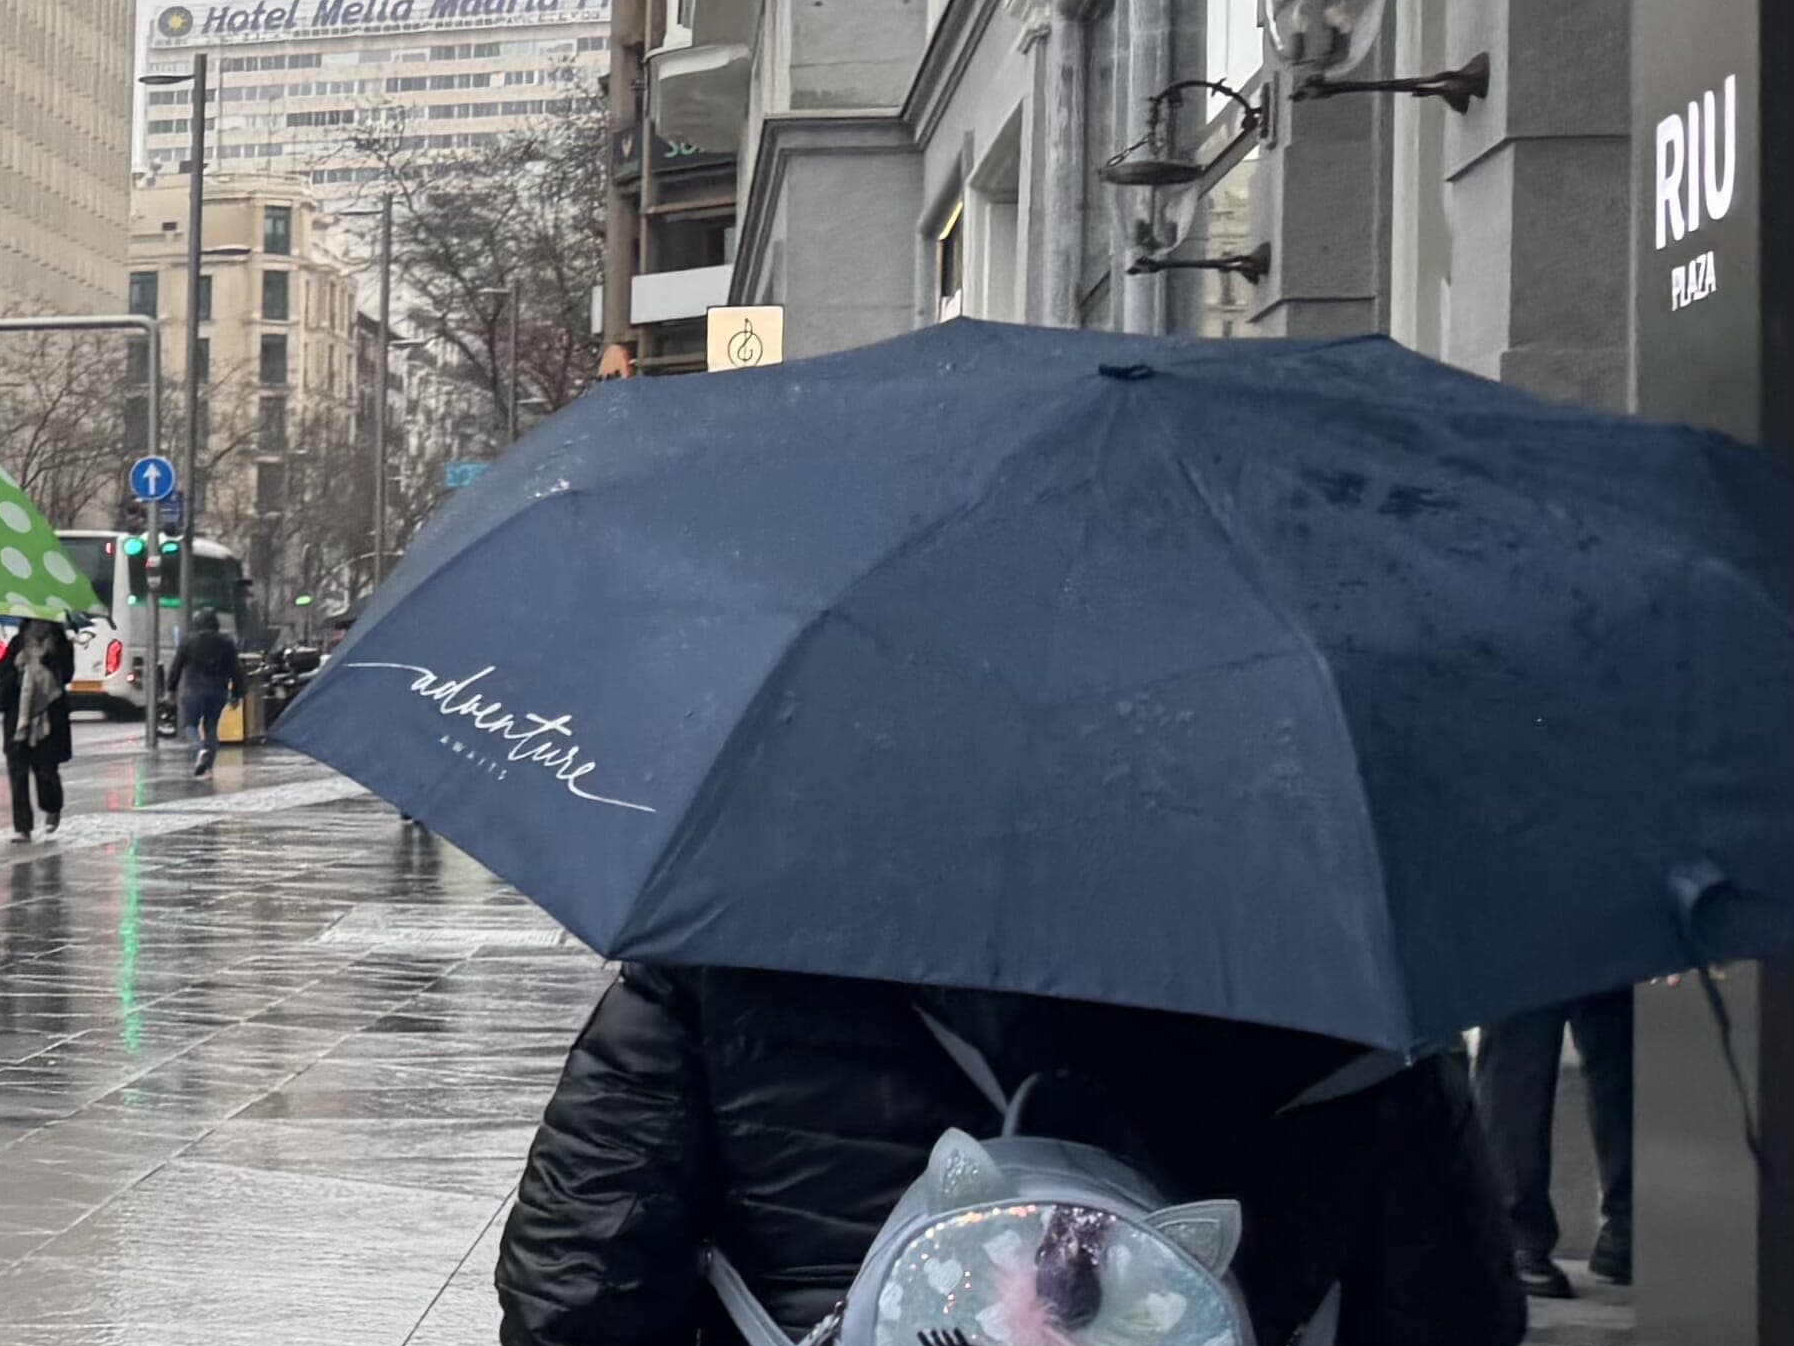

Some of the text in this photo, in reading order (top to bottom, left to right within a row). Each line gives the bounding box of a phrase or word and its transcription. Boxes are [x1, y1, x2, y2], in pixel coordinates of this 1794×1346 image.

[1655, 74, 1736, 250] RIU
[1671, 251, 1717, 311] PLAZA
[343, 662, 656, 812] adventure
[439, 735, 508, 781] AWAITS
